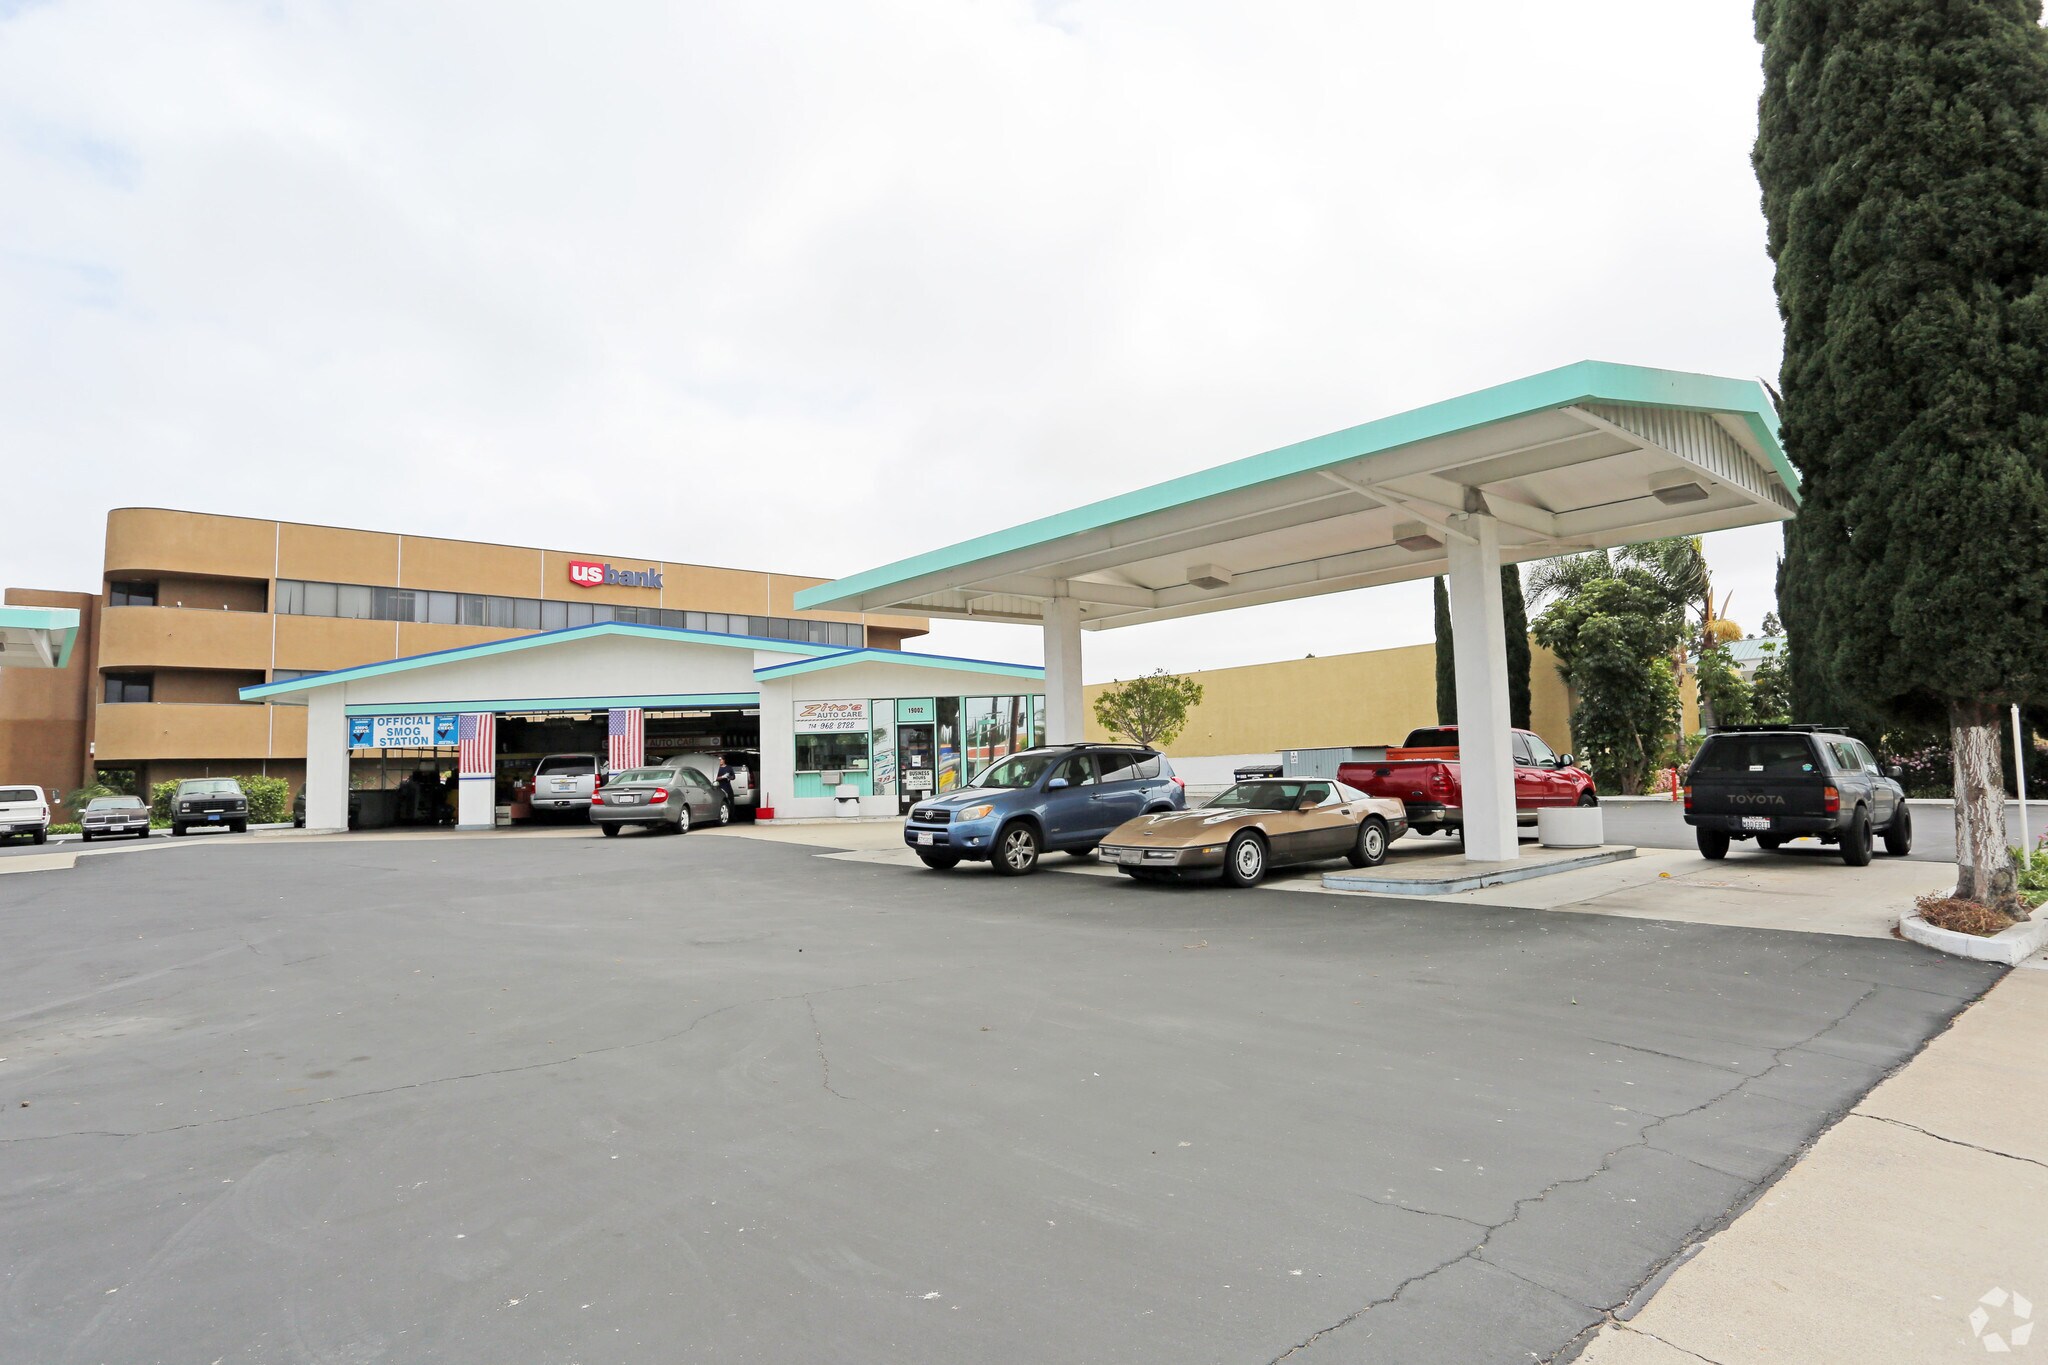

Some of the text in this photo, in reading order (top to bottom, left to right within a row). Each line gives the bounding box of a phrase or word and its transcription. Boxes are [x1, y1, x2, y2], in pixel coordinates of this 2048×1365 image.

[817, 709, 862, 718] AUTO CARE
[377, 716, 431, 726] OFFICIAL
[820, 721, 834, 729] 962
[386, 727, 421, 736] SMOG
[379, 736, 429, 746] STATION
[650, 738, 673, 747] AUTO
[1727, 794, 1785, 805] TOYOTA
